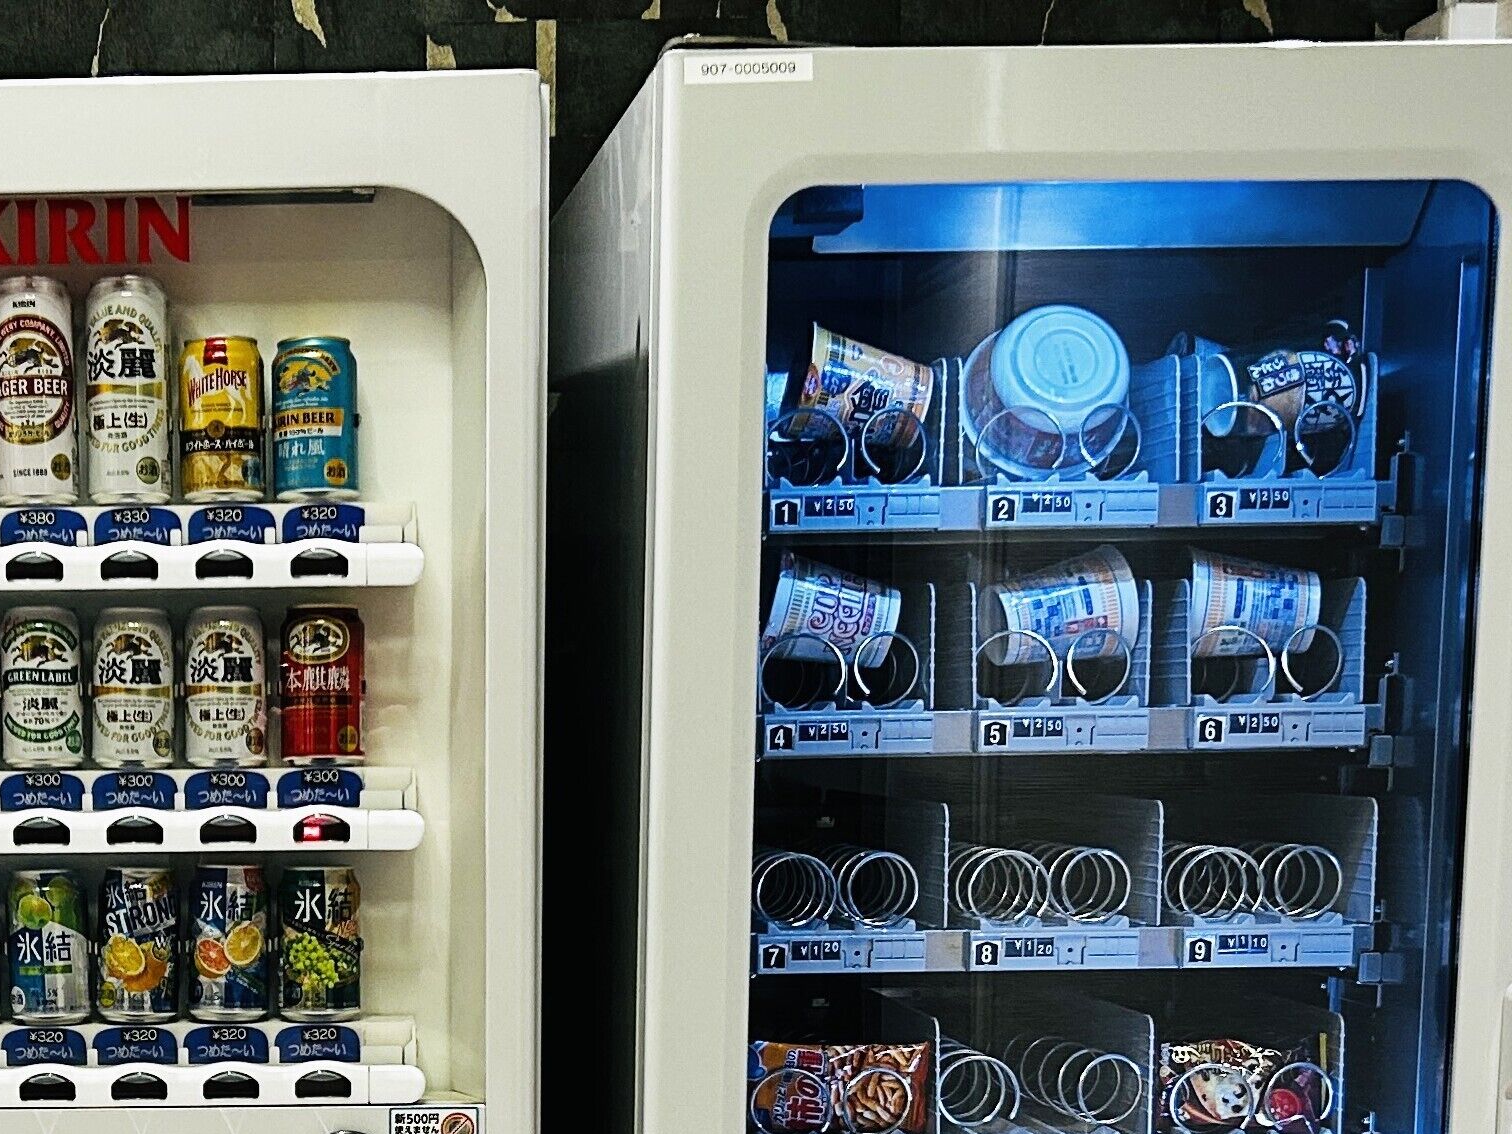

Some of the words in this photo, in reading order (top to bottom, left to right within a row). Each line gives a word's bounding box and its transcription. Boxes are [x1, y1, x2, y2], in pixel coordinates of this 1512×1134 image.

[701, 62, 796, 76] 907-0005009
[115, 304, 138, 317] AND
[88, 347, 156, 382] 淡麗
[33, 377, 68, 397] BEER
[302, 410, 336, 424] BEER
[122, 436, 149, 453] GOOD
[781, 503, 789, 522] 1
[814, 498, 855, 512] ¥250
[997, 500, 1009, 519] 2
[1216, 496, 1227, 515] 3
[1249, 490, 1289, 502] ¥250
[19, 511, 55, 525] ¥380
[114, 509, 150, 523] ¥330
[206, 508, 242, 522] ¥320
[301, 506, 337, 520] ¥320
[7, 669, 37, 683] GREEN
[41, 669, 73, 683] LABEL
[98, 657, 161, 685] 淡麗
[191, 655, 254, 684] 淡麗
[286, 664, 350, 692] 本麒麟
[989, 725, 1001, 743] 5
[1022, 718, 1062, 731] ¥250
[1204, 721, 1217, 740] 6
[1238, 714, 1279, 727] ¥250
[774, 731, 785, 747] 4
[808, 723, 848, 736] ¥250
[25, 774, 60, 787] ¥300
[118, 773, 153, 787] ¥300
[210, 772, 245, 786] ¥300
[303, 769, 338, 783] ¥300
[200, 890, 254, 922] 氷結
[294, 888, 354, 924] 氷結
[16, 931, 72, 964] 氷結
[768, 948, 780, 967] 7
[800, 940, 840, 957] ¥120
[980, 945, 993, 965] 8
[1013, 939, 1054, 956] ¥120
[1194, 942, 1206, 963] 9
[1226, 934, 1269, 950] ¥110
[29, 1031, 64, 1043] ¥320
[122, 1029, 157, 1041] ¥320
[212, 1028, 247, 1040] ¥320
[302, 1027, 337, 1040] ¥320
[394, 1113, 440, 1125] 新500円
[394, 1125, 440, 1134] 使えません
